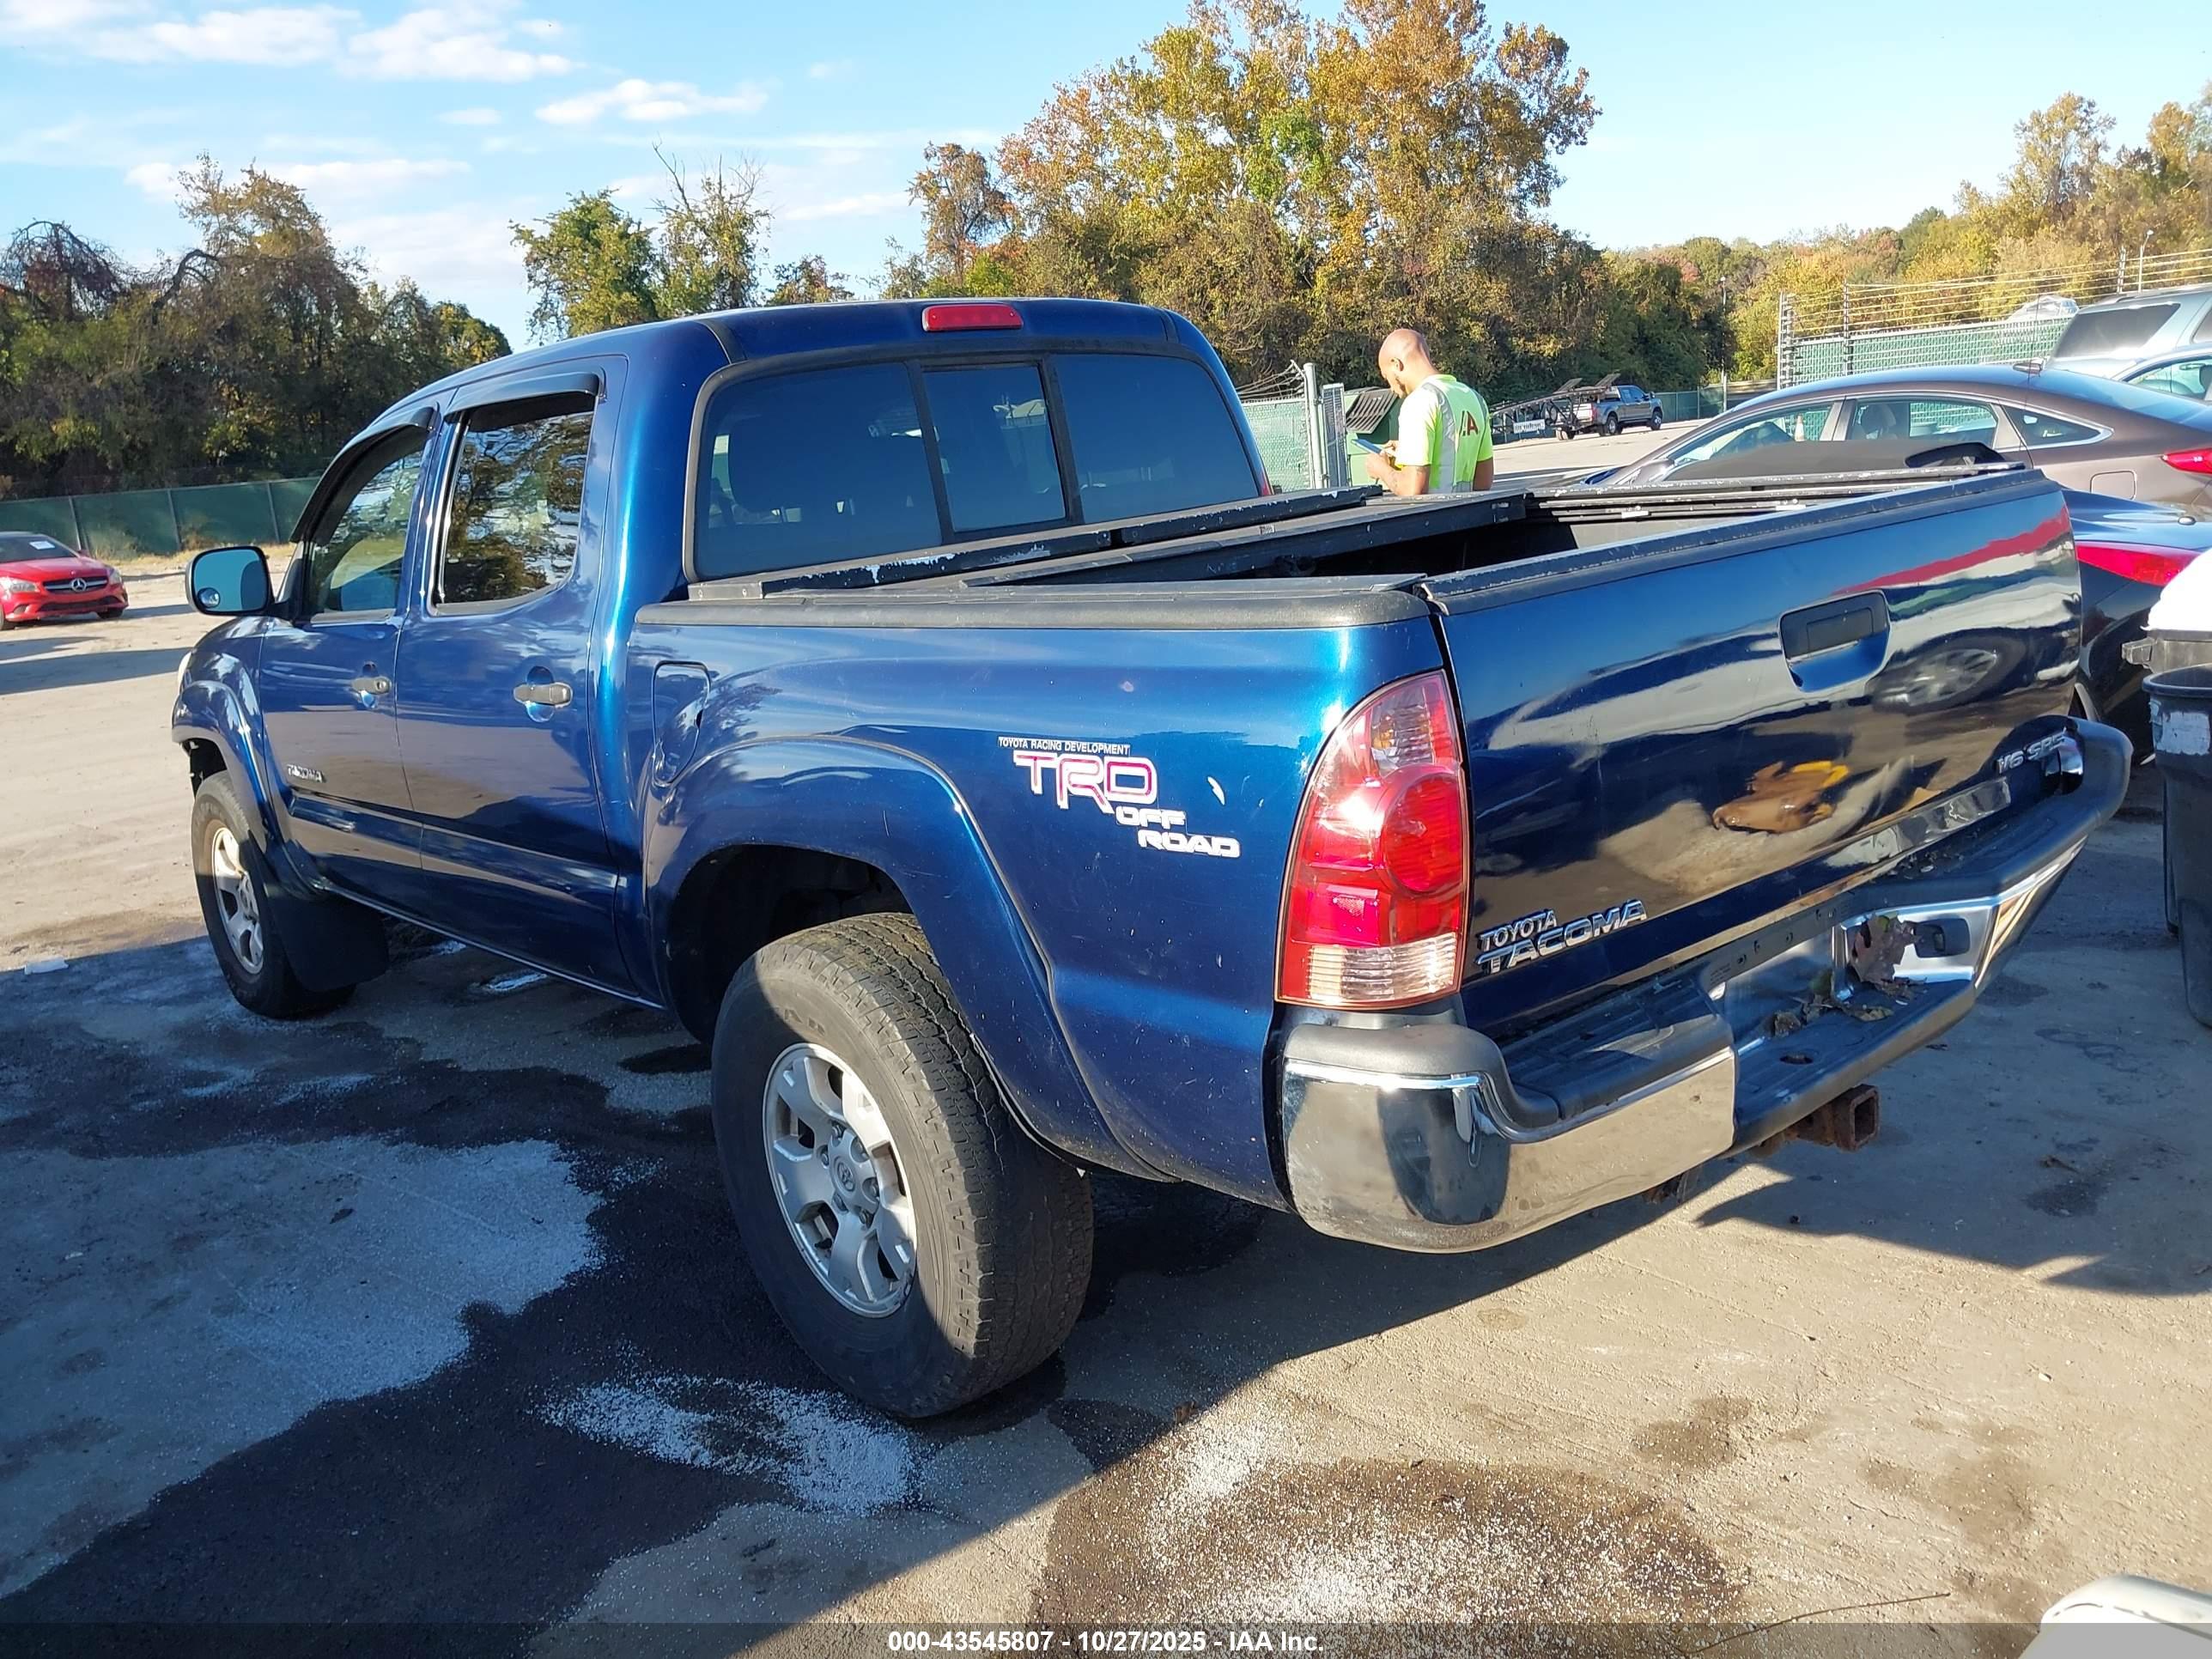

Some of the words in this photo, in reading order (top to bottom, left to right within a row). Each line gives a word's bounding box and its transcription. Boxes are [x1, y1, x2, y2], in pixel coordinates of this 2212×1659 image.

[998, 736, 1029, 749] TOYOTA
[1030, 739, 1062, 750] RACING
[1064, 741, 1130, 756] DEVELOPMENT
[1997, 750, 2024, 774] V6
[1013, 750, 1158, 814] TRD
[1115, 805, 1186, 829] OFF
[1138, 829, 1241, 858] ROAD
[1474, 900, 1648, 974] TACOMA
[1478, 909, 1558, 951] TOYOTA
